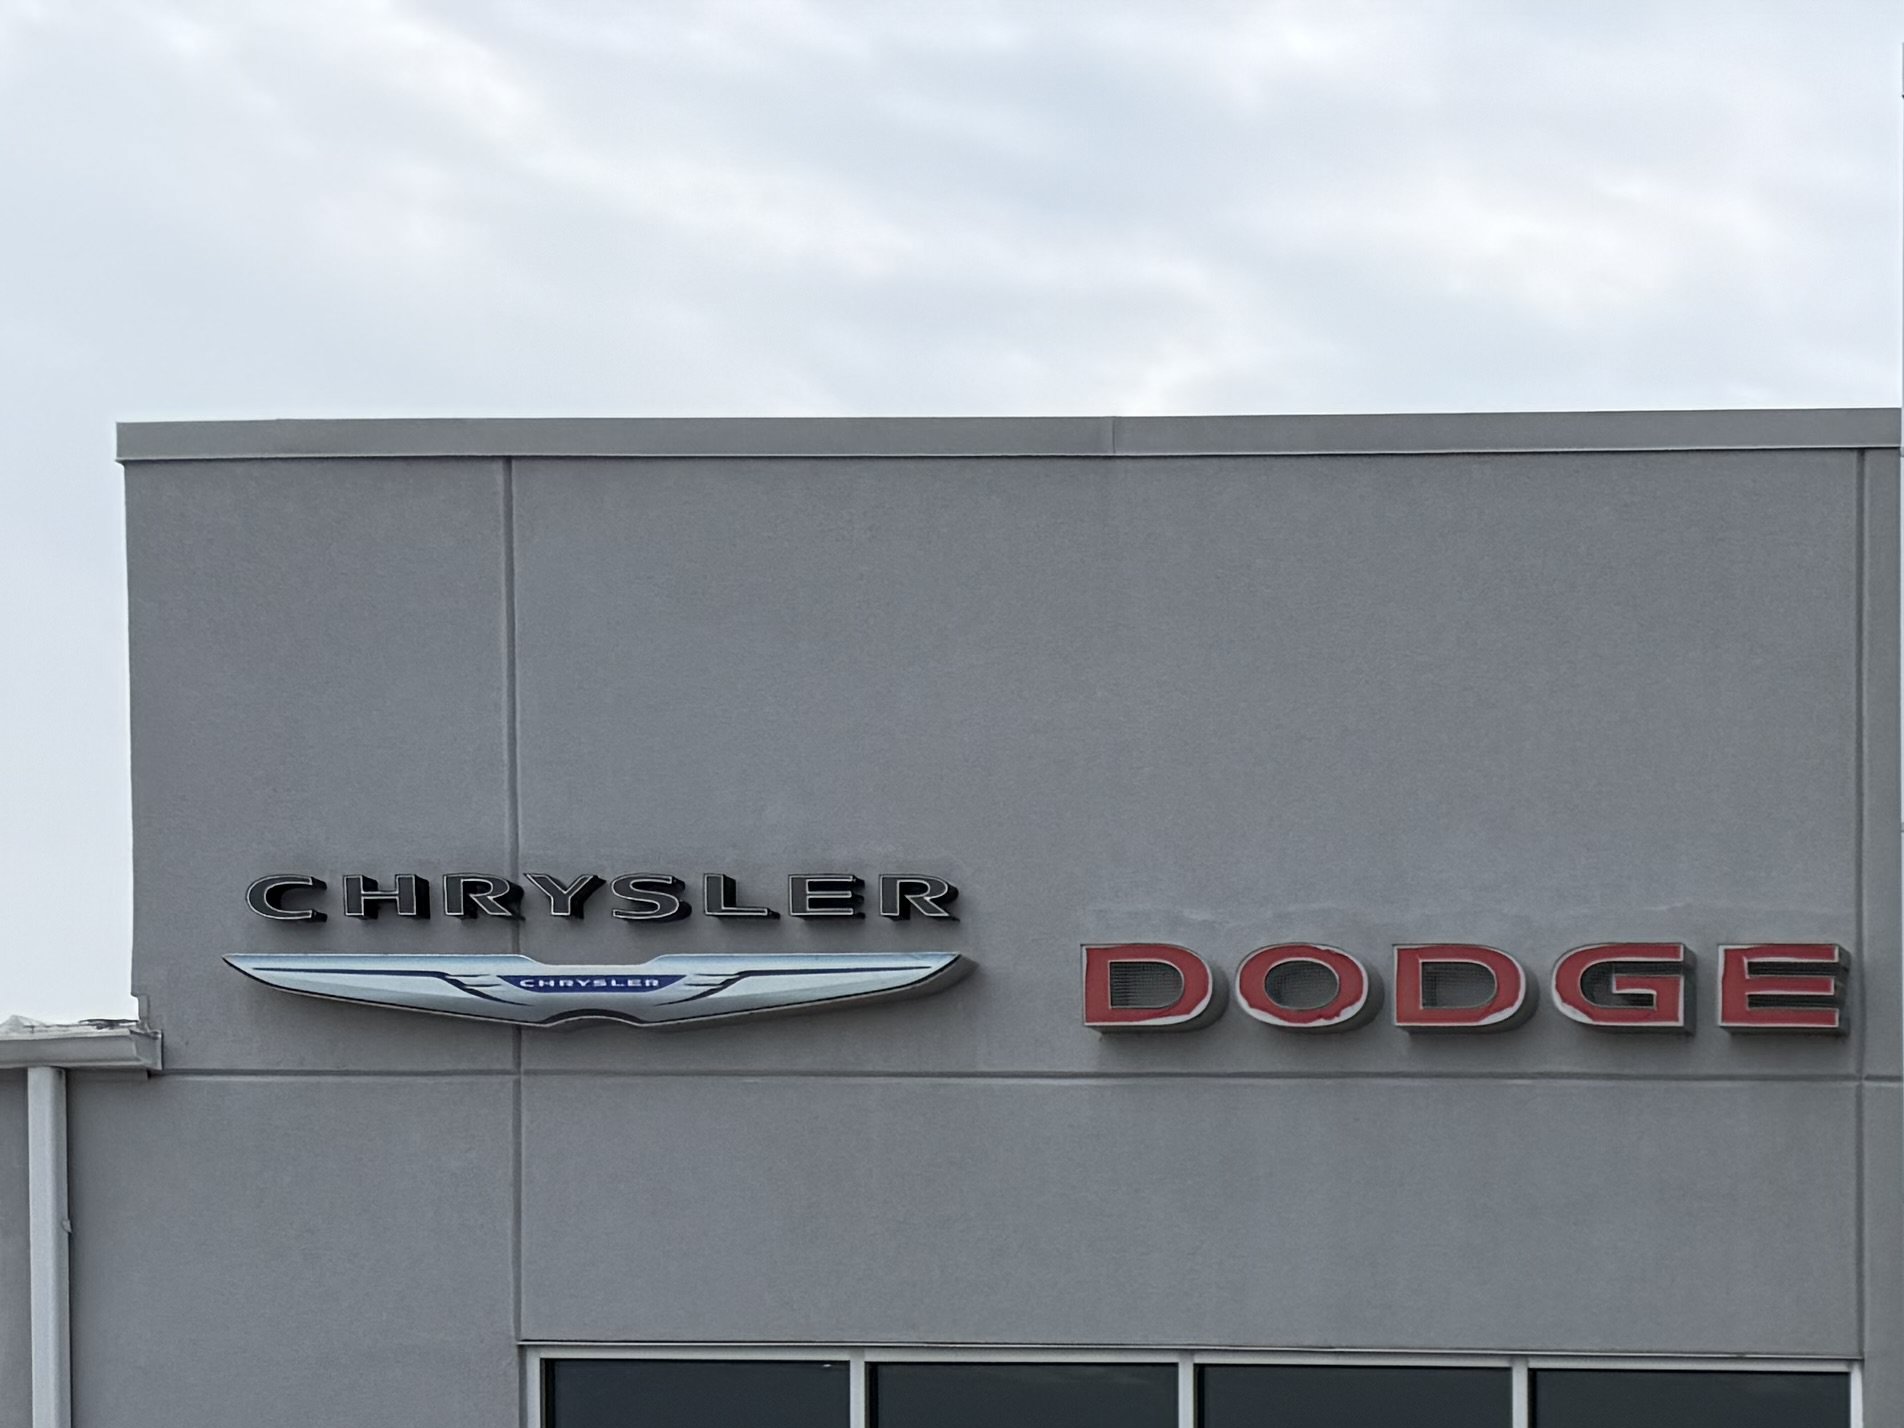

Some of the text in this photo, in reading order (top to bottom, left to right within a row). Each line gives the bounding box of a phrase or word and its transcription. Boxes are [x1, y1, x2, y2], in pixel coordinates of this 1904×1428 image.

[244, 872, 960, 923] CHRYSLER
[519, 979, 659, 988] CHRYSLER
[1080, 940, 1851, 1034] DODGE
